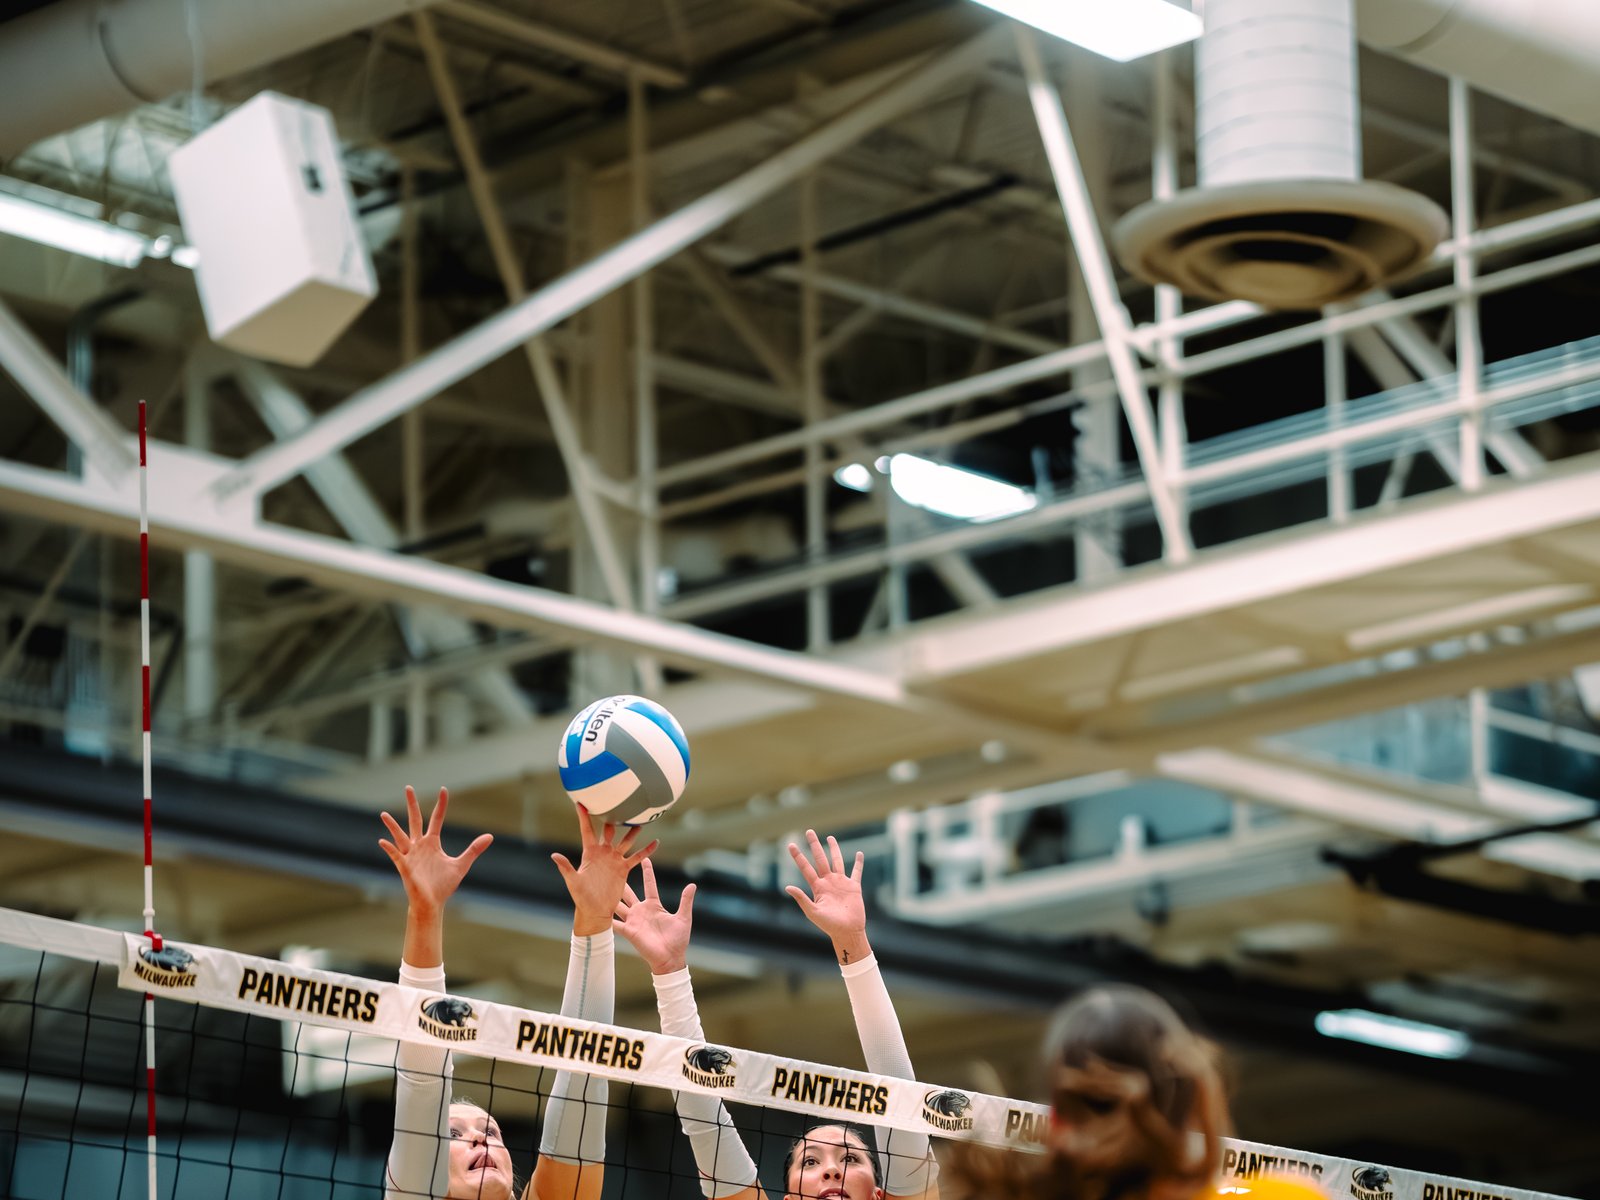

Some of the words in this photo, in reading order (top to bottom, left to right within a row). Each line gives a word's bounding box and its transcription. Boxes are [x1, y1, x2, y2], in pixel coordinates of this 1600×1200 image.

[134, 961, 197, 987] MILWAUKEE
[238, 968, 379, 1022] PANTHERS
[418, 1016, 477, 1041] MILWAUKEE
[516, 1020, 645, 1070] PANTHERS
[682, 1063, 736, 1088] MILWAUKEE
[771, 1067, 889, 1115] PANTHERS
[922, 1108, 973, 1131] MILWAUKEE
